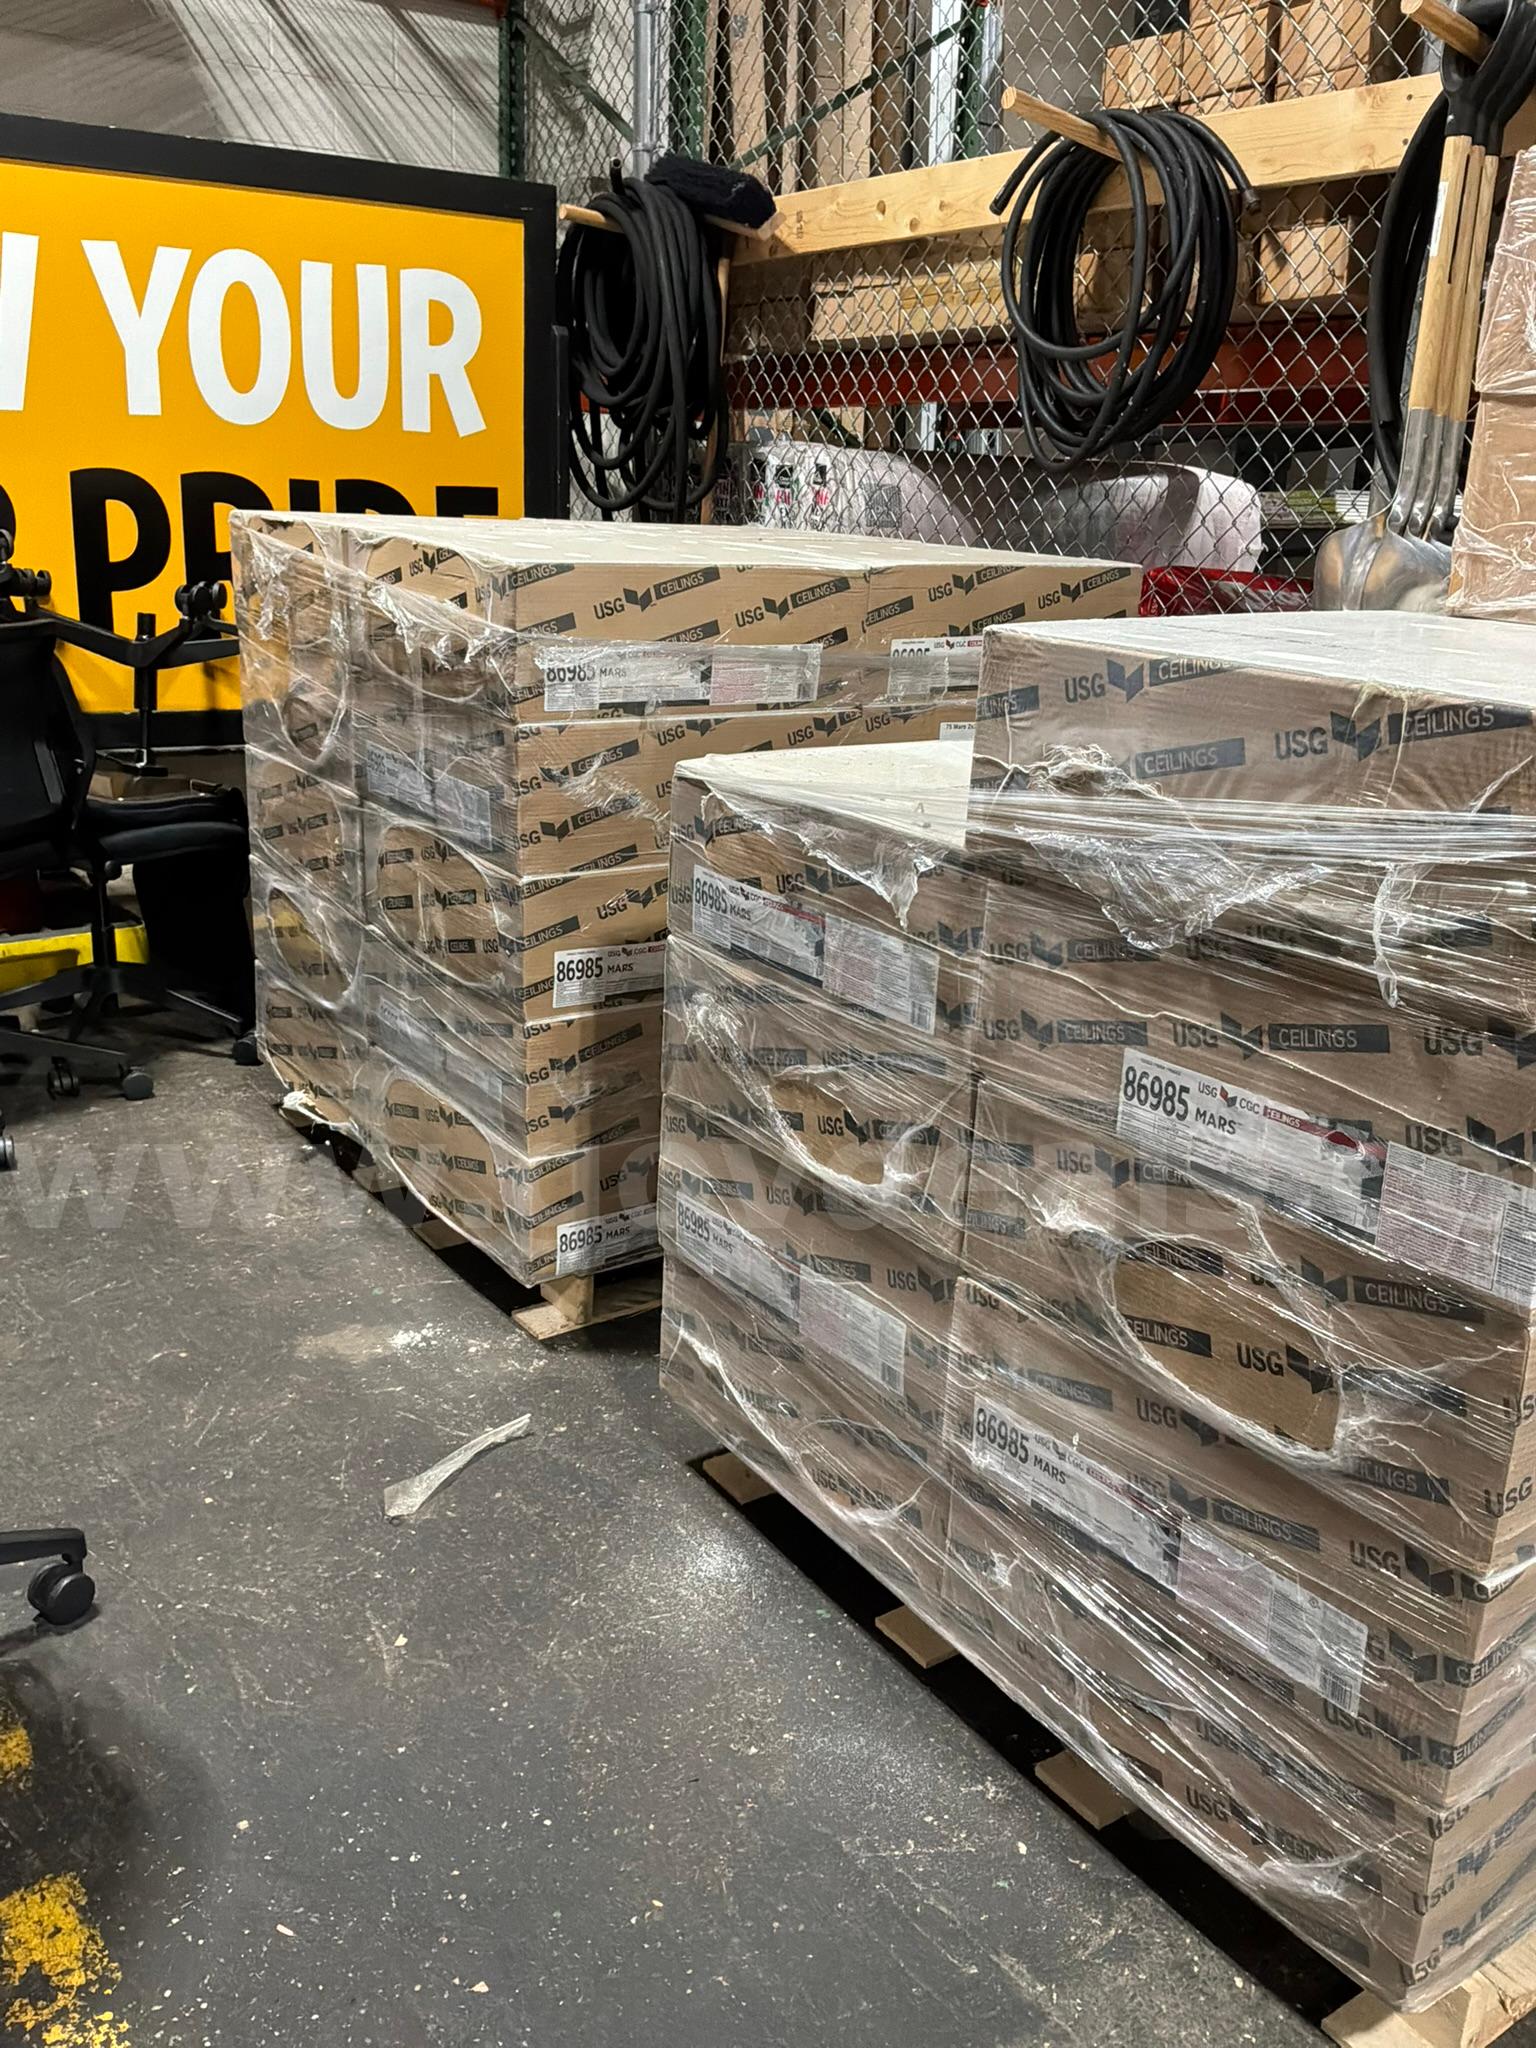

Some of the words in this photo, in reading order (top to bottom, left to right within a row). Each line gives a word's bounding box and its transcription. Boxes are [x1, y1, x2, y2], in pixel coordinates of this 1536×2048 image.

[80, 239, 487, 438] YOUR
[409, 558, 423, 577] USG
[511, 563, 557, 586] CEILINGS
[594, 598, 625, 620] USG
[660, 573, 704, 596] CEILINGS
[928, 583, 953, 602] USG
[1038, 590, 1060, 610] USG
[1086, 569, 1121, 589] CEILINGS
[735, 606, 764, 628] USG
[796, 582, 836, 604] CEILINGS
[1065, 674, 1105, 703] USG
[658, 725, 686, 746] USG
[788, 726, 815, 746] USG
[865, 713, 890, 733] USG
[1275, 727, 1328, 760] USG
[1404, 705, 1494, 737] CEILINGS
[577, 748, 623, 772] CEILINGS
[1144, 750, 1218, 774] CEILINGS
[577, 801, 622, 826] CEILINGS
[695, 879, 727, 914] 86985
[776, 873, 804, 894] USG
[596, 896, 628, 920] USG
[989, 942, 1030, 963] USG
[556, 957, 604, 982] 86985
[607, 964, 634, 973] MARS
[983, 1019, 1021, 1041] USG
[1065, 1023, 1125, 1042] CEILINGS
[1172, 1020, 1218, 1048] USG
[1278, 1028, 1357, 1049] CEILINGS
[1424, 1026, 1483, 1056] USG
[1123, 1065, 1190, 1121] 86985
[1195, 1107, 1236, 1136] MARS
[1198, 1081, 1217, 1098] USG
[1239, 1097, 1260, 1115] CGC
[1267, 1107, 1301, 1128] CEILINGS
[666, 1115, 686, 1134] USG
[818, 1116, 844, 1136] USG
[1405, 1124, 1463, 1157] USG
[527, 1156, 569, 1181] CEILINGS
[1056, 1148, 1093, 1174] USG
[600, 1170, 627, 1192] USG
[766, 1186, 793, 1206] USG
[677, 1201, 711, 1243] 86985
[559, 1226, 602, 1253] 86985
[606, 1226, 630, 1239] MARS
[887, 1268, 918, 1292] USG
[967, 1284, 999, 1310] USG
[1365, 1283, 1450, 1314] CEILINGS
[1236, 1343, 1285, 1377] USG
[1136, 1398, 1178, 1430] USG
[976, 1408, 1029, 1464] 86985
[1034, 1456, 1067, 1485] MARS
[812, 1469, 837, 1492] USG
[1355, 1459, 1418, 1492] ILINGS
[1484, 1476, 1532, 1519] USG
[1221, 1504, 1293, 1542] CEILINGS
[1351, 1540, 1402, 1579] USG
[1186, 1785, 1229, 1823] USG
[1413, 1874, 1455, 1916] USG
[1401, 1951, 1442, 1986] USG
